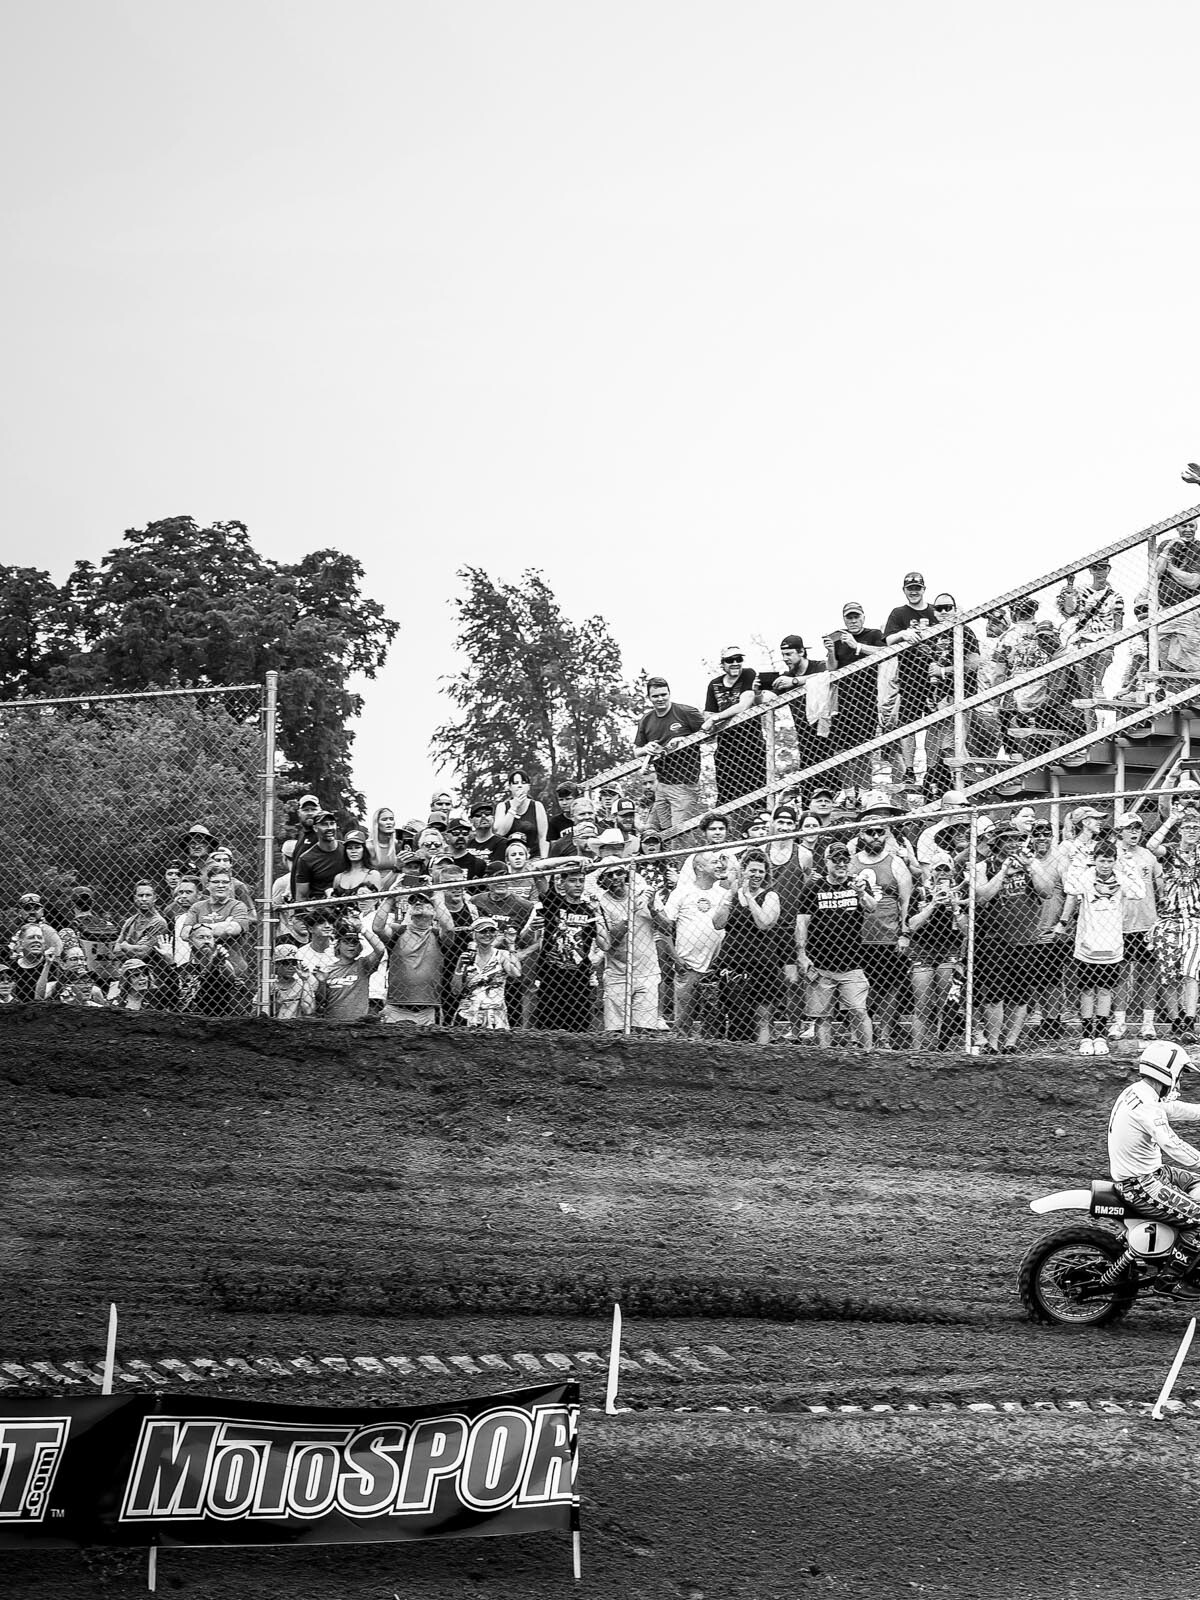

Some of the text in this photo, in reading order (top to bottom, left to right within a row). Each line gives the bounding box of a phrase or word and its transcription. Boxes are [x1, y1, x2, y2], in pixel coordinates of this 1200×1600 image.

[1166, 1049, 1178, 1069] 1
[1094, 1205, 1125, 1216] RM250
[1144, 1223, 1157, 1253] 1
